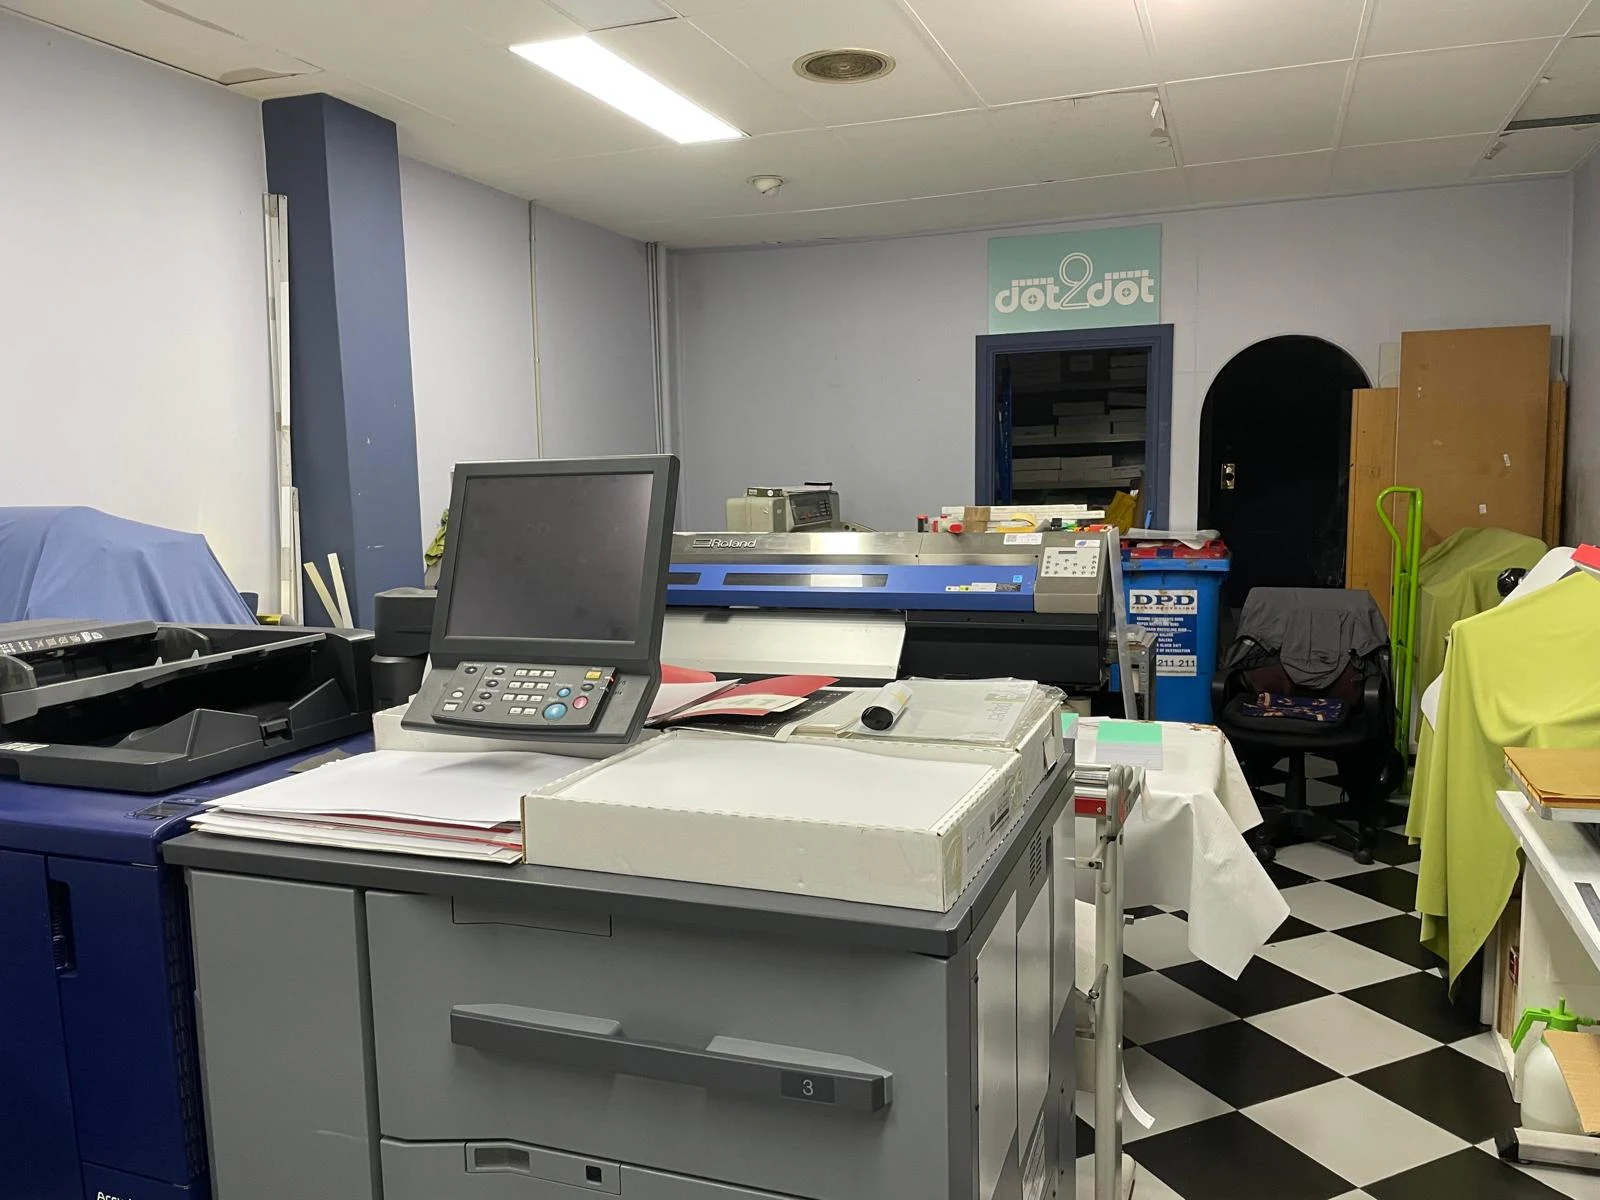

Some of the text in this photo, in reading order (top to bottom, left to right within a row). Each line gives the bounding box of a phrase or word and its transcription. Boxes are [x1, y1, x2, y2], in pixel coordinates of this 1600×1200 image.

[995, 252, 1154, 313] dot2dot
[711, 538, 757, 548] Roland
[1132, 595, 1195, 605] DPD
[1157, 659, 1195, 667] 211 211
[802, 1079, 814, 1096] 3
